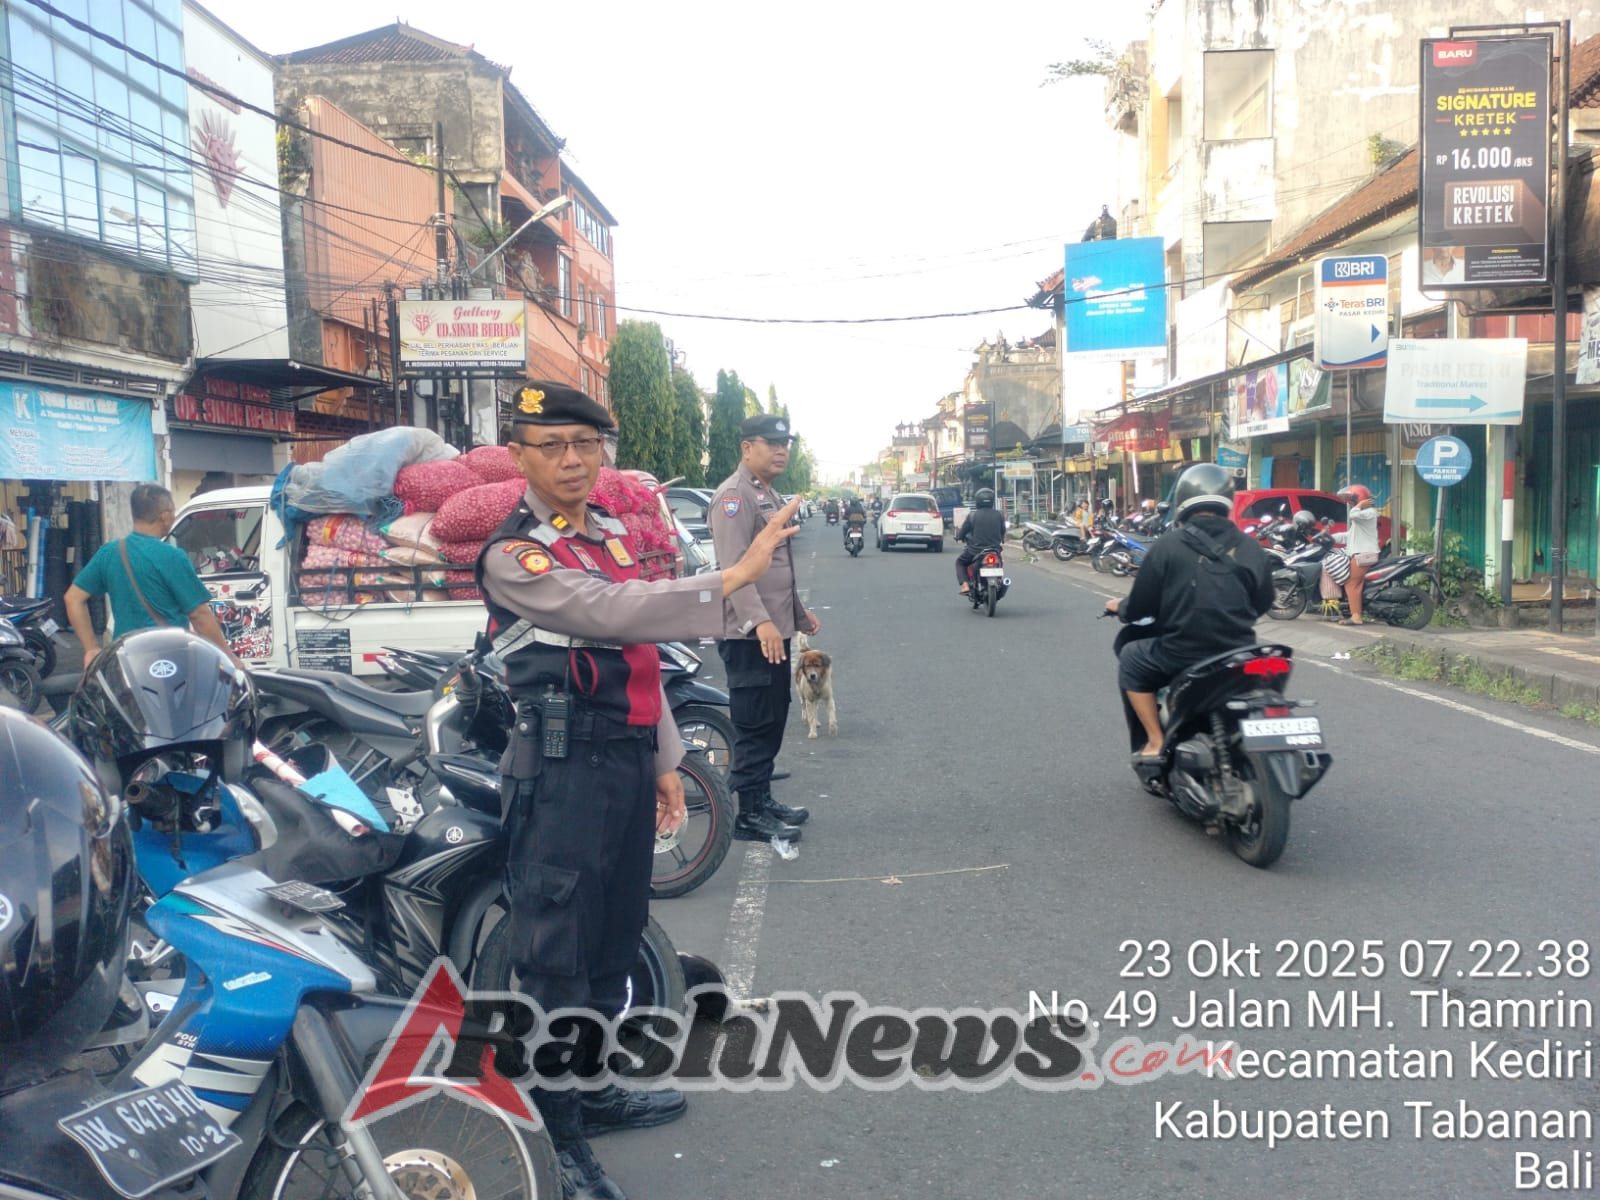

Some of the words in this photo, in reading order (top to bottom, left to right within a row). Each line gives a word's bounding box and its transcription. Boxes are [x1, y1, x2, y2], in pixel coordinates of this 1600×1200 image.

[1438, 49, 1473, 59] BARU
[1436, 91, 1537, 111] SIGNATURE
[1454, 111, 1517, 126] KRETEK
[1436, 155, 1448, 165] RP
[1451, 146, 1512, 170] 16.000
[1453, 185, 1515, 205] REVOLUSI
[1453, 205, 1514, 225] KRETEK
[1350, 261, 1375, 276] BRI
[1339, 299, 1366, 309] Teras
[1366, 298, 1385, 308] BRI
[481, 322, 521, 337] BERLIAN
[1417, 380, 1458, 388] Traditional
[202, 398, 245, 427] SINAR
[1433, 440, 1459, 466] P
[73, 1116, 127, 1152] DK
[115, 1094, 177, 1135] 6475
